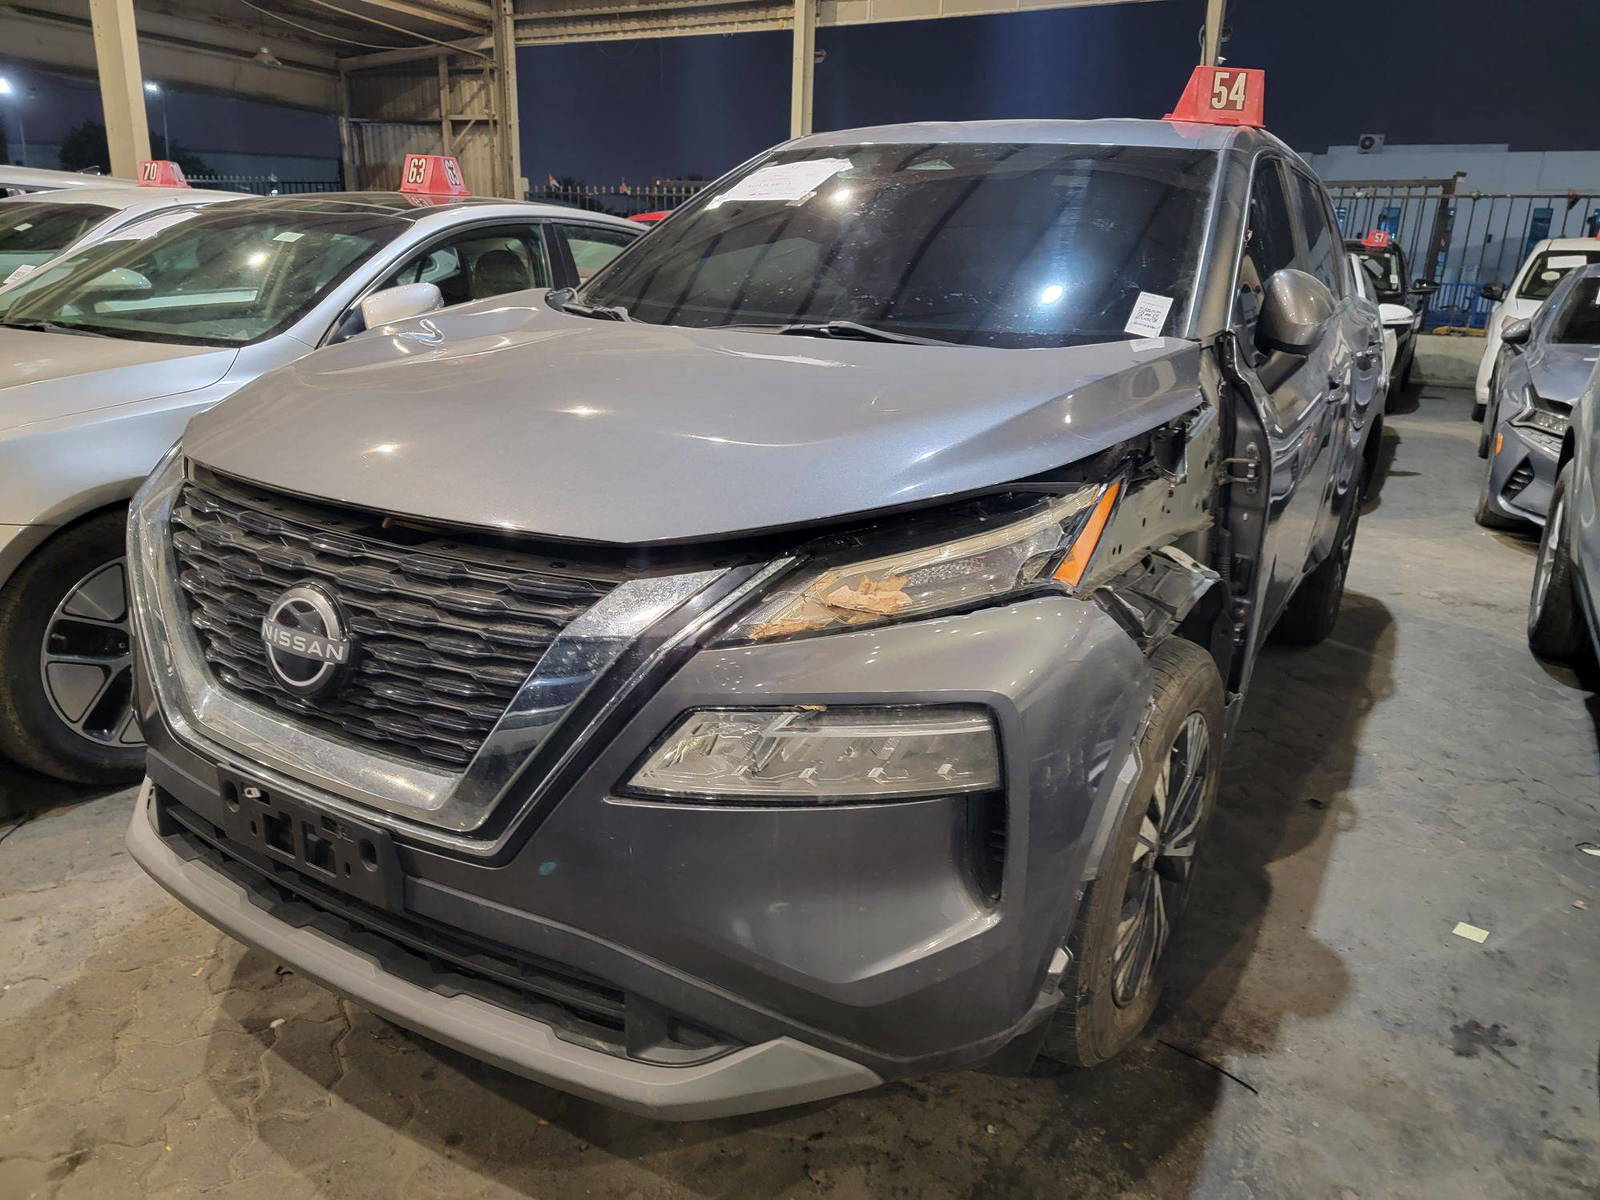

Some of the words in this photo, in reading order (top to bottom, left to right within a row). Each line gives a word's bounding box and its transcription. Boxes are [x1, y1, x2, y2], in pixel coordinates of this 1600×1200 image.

[1211, 71, 1247, 110] 54
[143, 162, 158, 180] 70
[408, 158, 426, 184] 63
[262, 622, 344, 661] NISSAN
